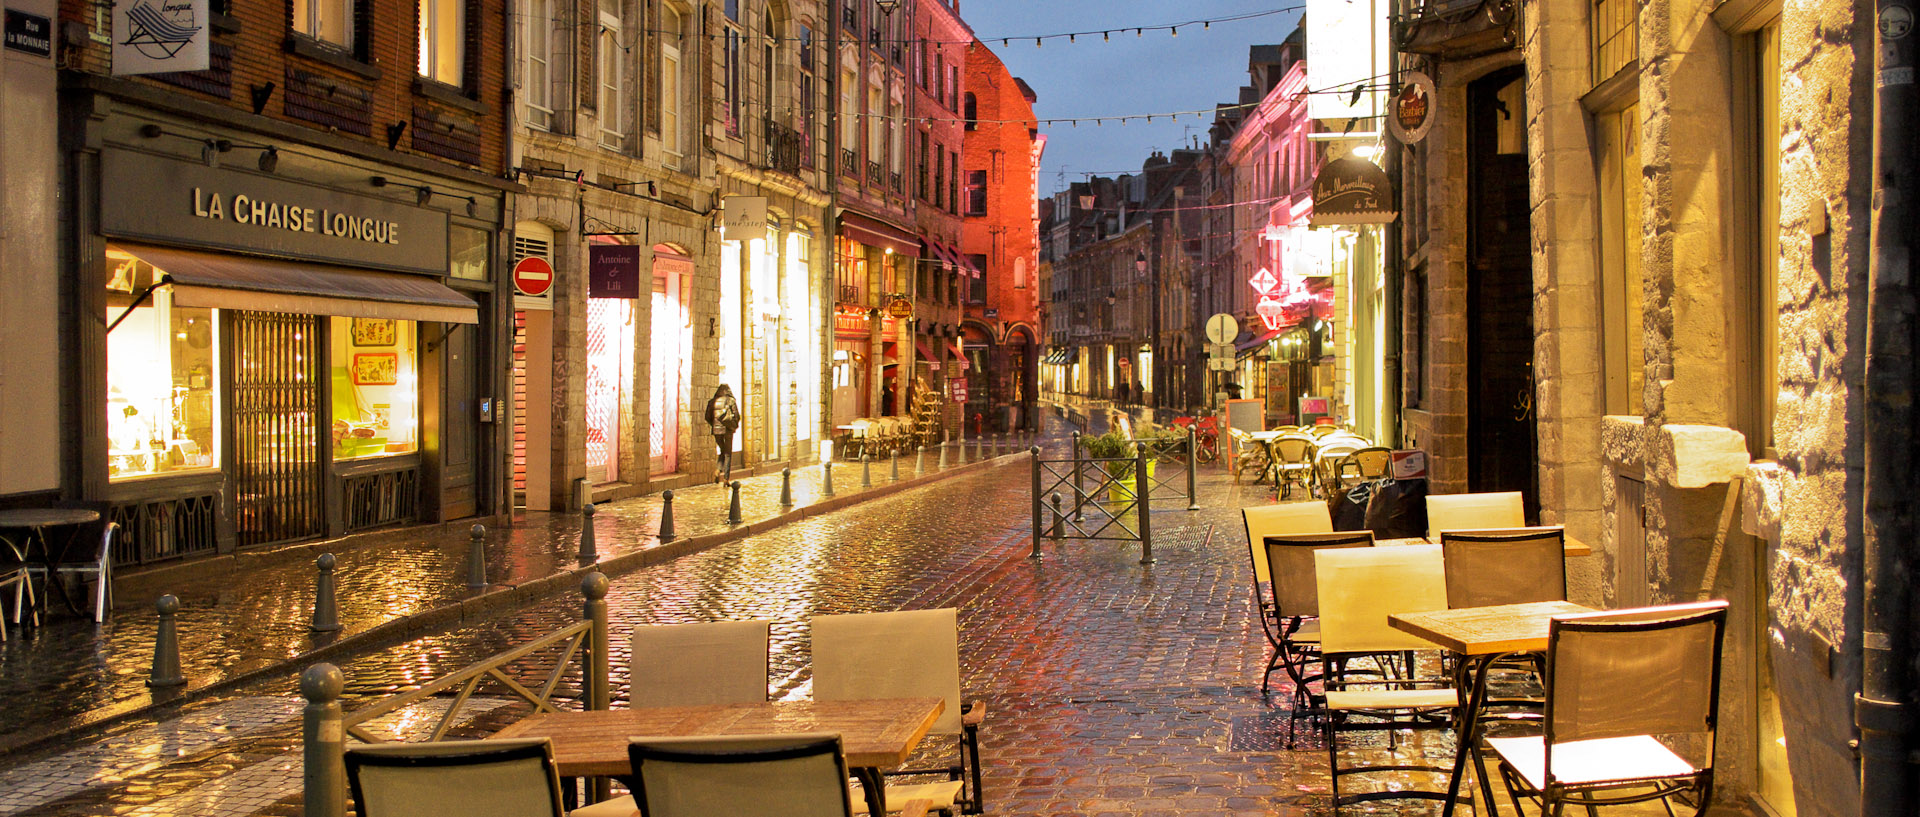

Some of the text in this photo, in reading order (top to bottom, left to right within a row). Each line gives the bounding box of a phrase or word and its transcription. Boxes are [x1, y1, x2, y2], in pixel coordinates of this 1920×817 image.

[161, 0, 193, 16] longue
[25, 19, 40, 33] Rue
[7, 32, 15, 43] la
[16, 34, 50, 51] MONNAIE
[1399, 105, 1426, 119] Barbier
[1316, 182, 1332, 201] Aux
[1353, 197, 1379, 209] de Fred
[193, 187, 400, 246] LA CHAISE LONGUE
[597, 254, 631, 264] Antoine
[608, 266, 619, 277] &
[606, 281, 621, 291] Lili
